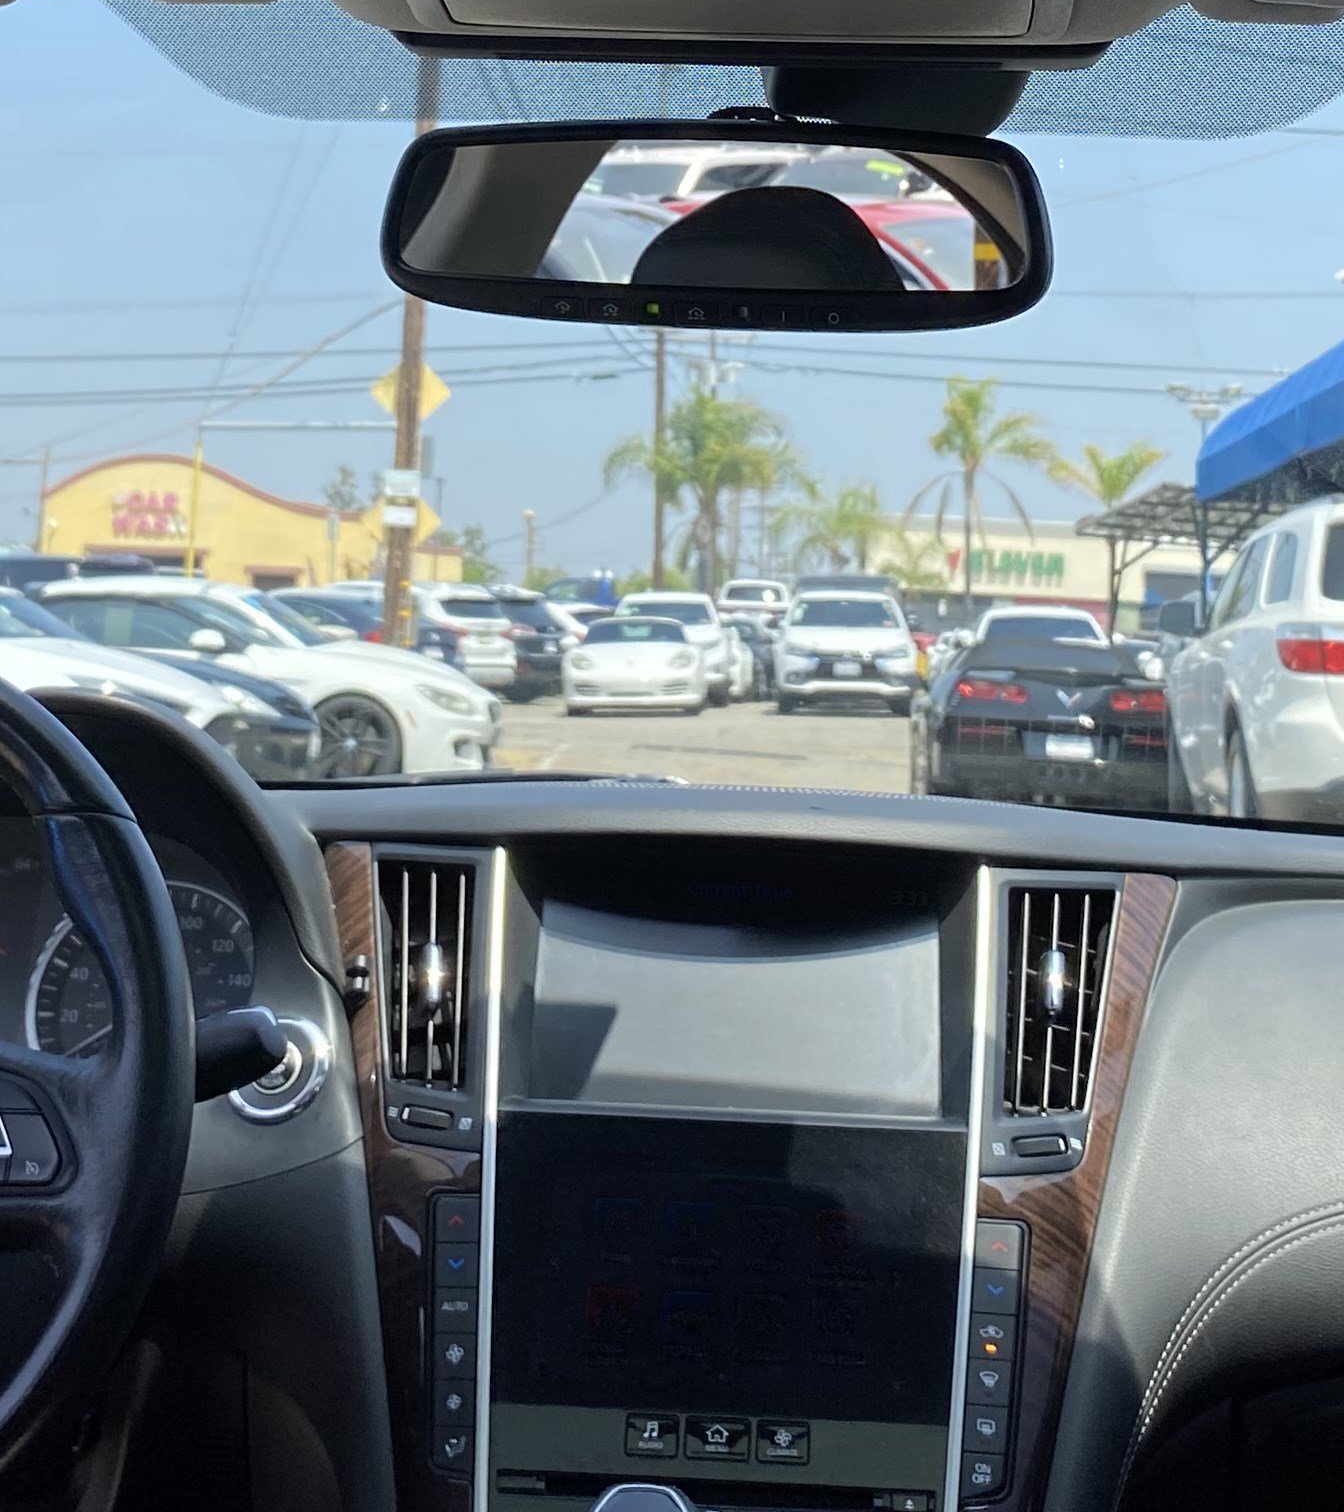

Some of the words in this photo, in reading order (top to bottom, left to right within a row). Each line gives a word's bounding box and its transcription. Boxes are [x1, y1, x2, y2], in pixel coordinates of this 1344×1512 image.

[128, 490, 179, 510] CAR
[212, 939, 235, 953] 120
[69, 966, 89, 981] 40
[227, 974, 251, 988] 140
[60, 1008, 80, 1023] 20
[441, 1301, 469, 1311] AUTO
[975, 1463, 992, 1474] ON
[971, 1473, 992, 1485] OFF
